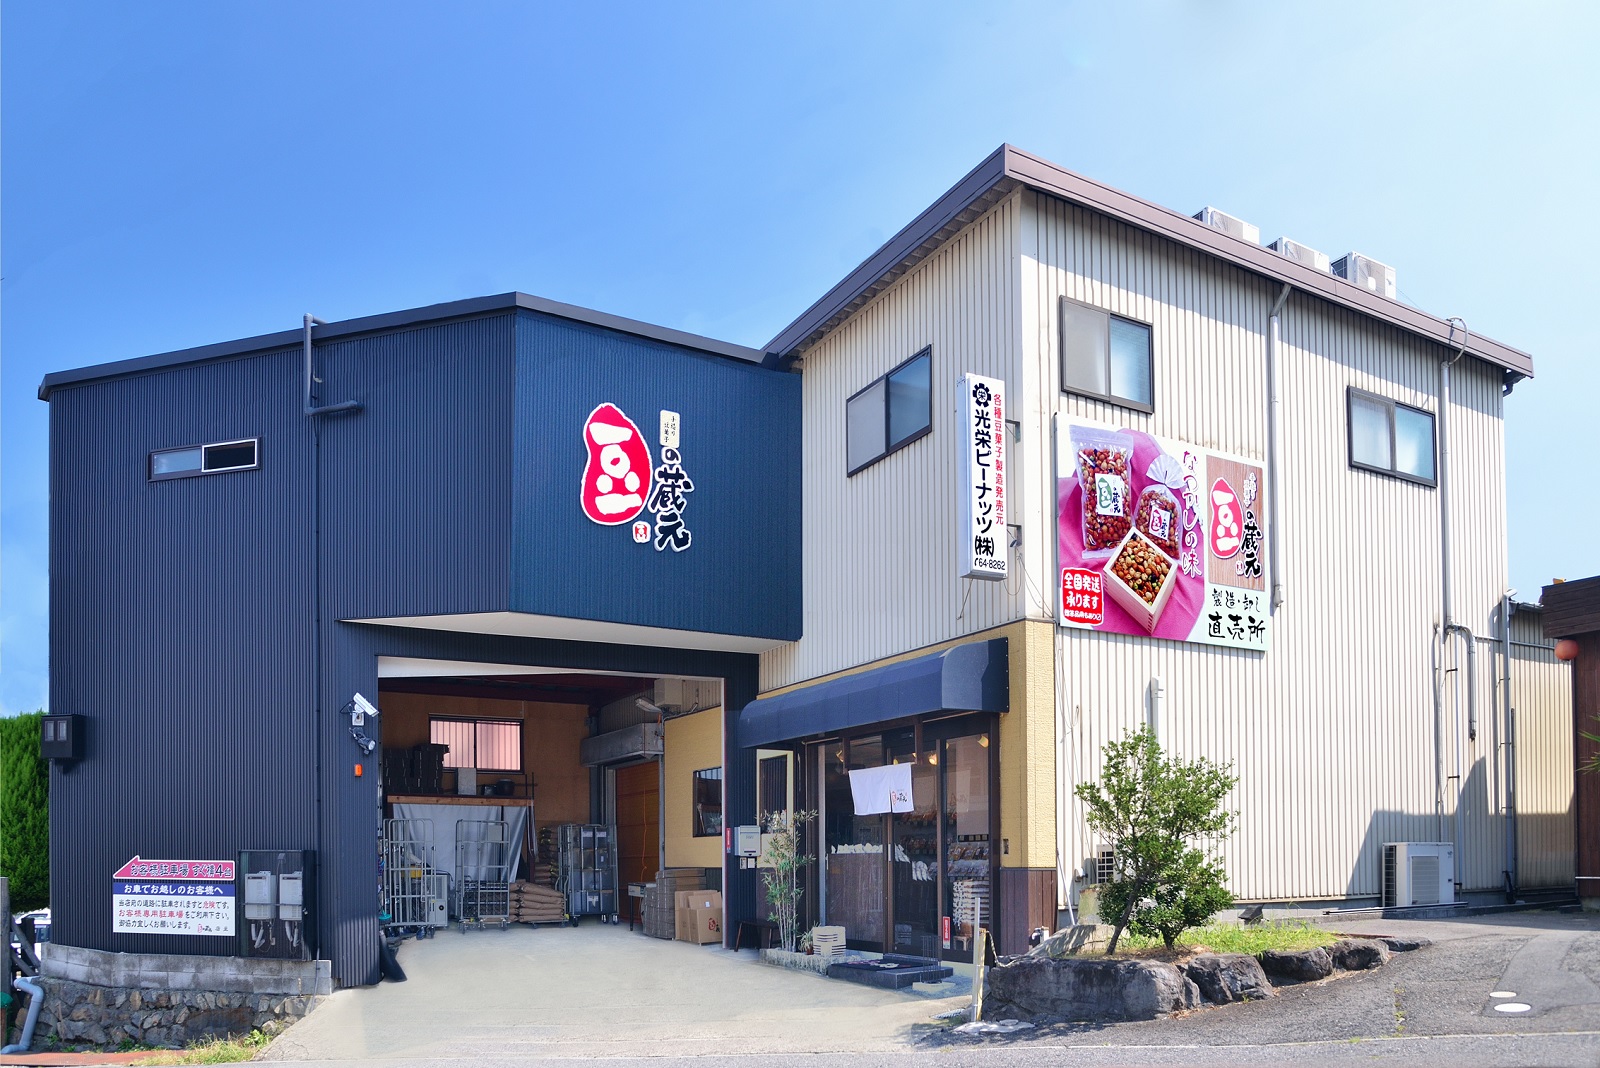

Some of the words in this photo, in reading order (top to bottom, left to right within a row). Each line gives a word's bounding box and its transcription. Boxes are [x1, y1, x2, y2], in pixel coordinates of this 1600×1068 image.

[1183, 450, 1202, 577] なつかしの味
[1064, 572, 1101, 593] 全国発送
[1066, 591, 1099, 609] 承ります
[1208, 611, 1266, 644] 直売所
[124, 884, 223, 895] お車でお越しのお客様へ
